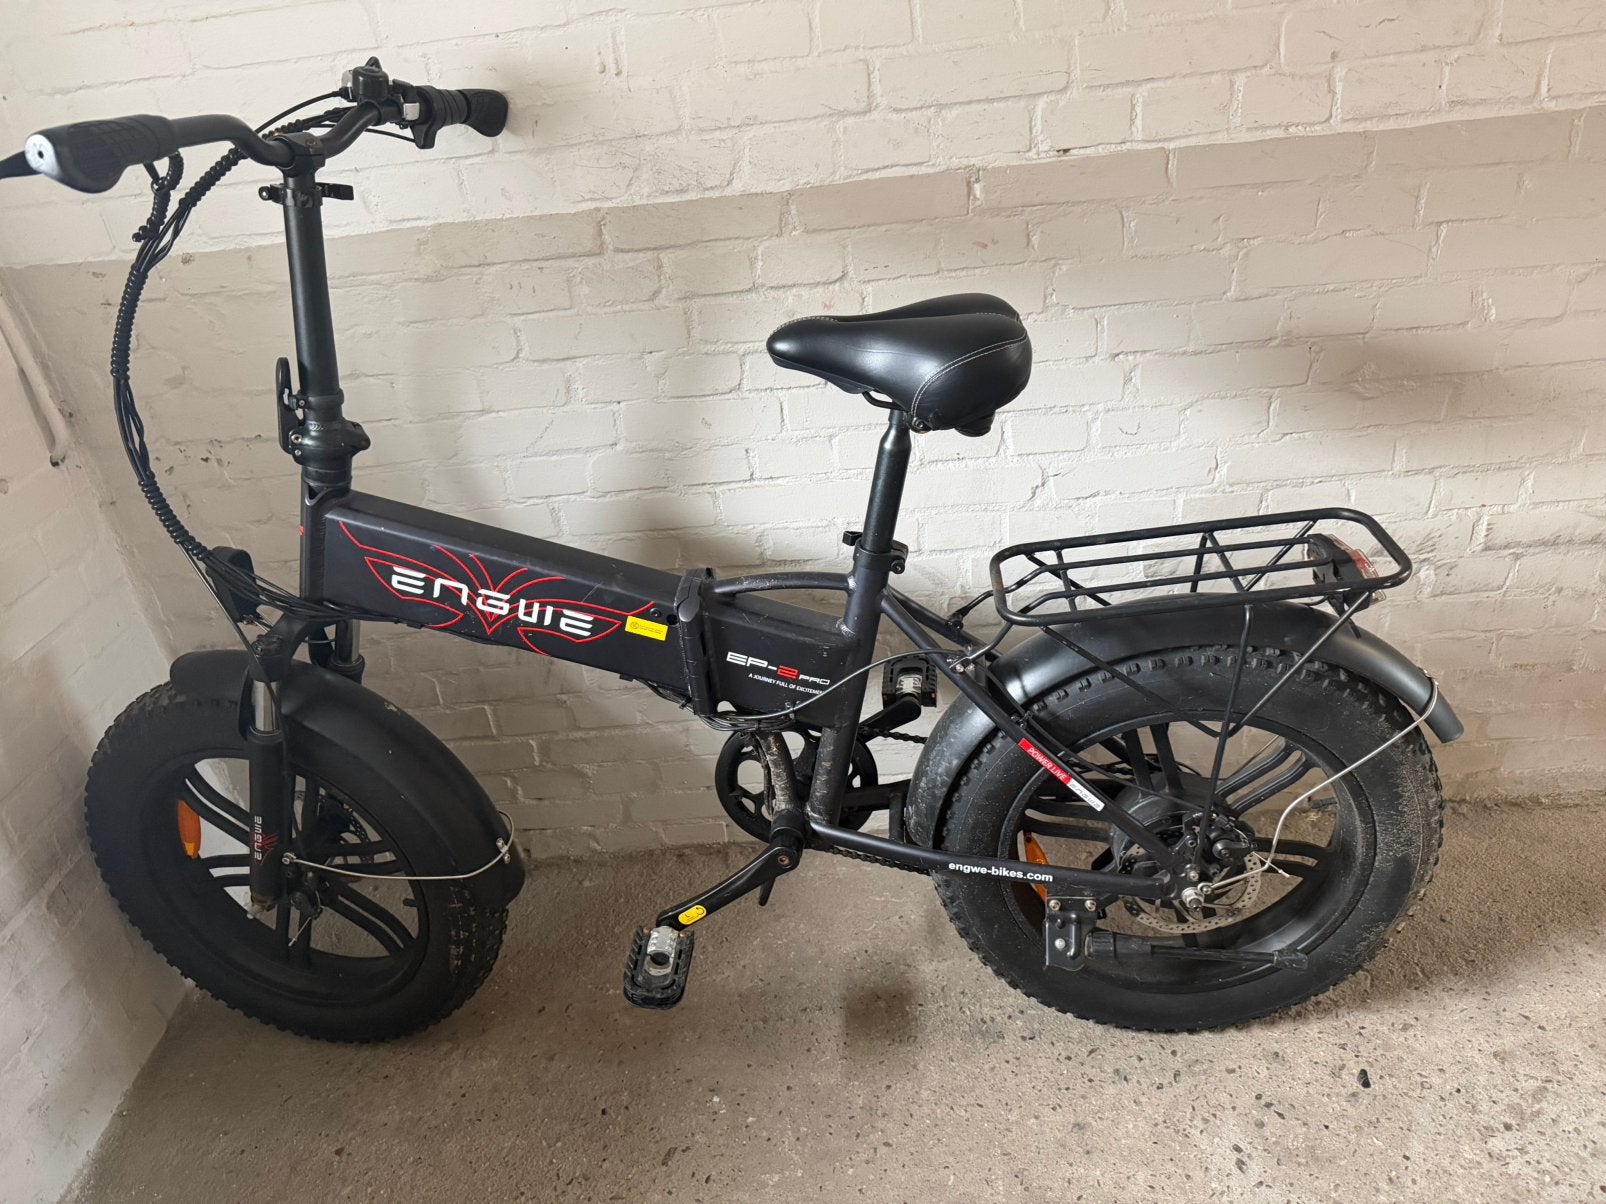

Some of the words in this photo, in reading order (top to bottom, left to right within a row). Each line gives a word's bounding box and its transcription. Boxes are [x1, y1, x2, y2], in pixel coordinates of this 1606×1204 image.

[753, 674, 776, 684] JOURNEY
[776, 680, 788, 688] FULL
[1027, 747, 1053, 769] POWER
[1050, 765, 1067, 780] LIVE
[948, 862, 1053, 882] engwe-bikes.com
